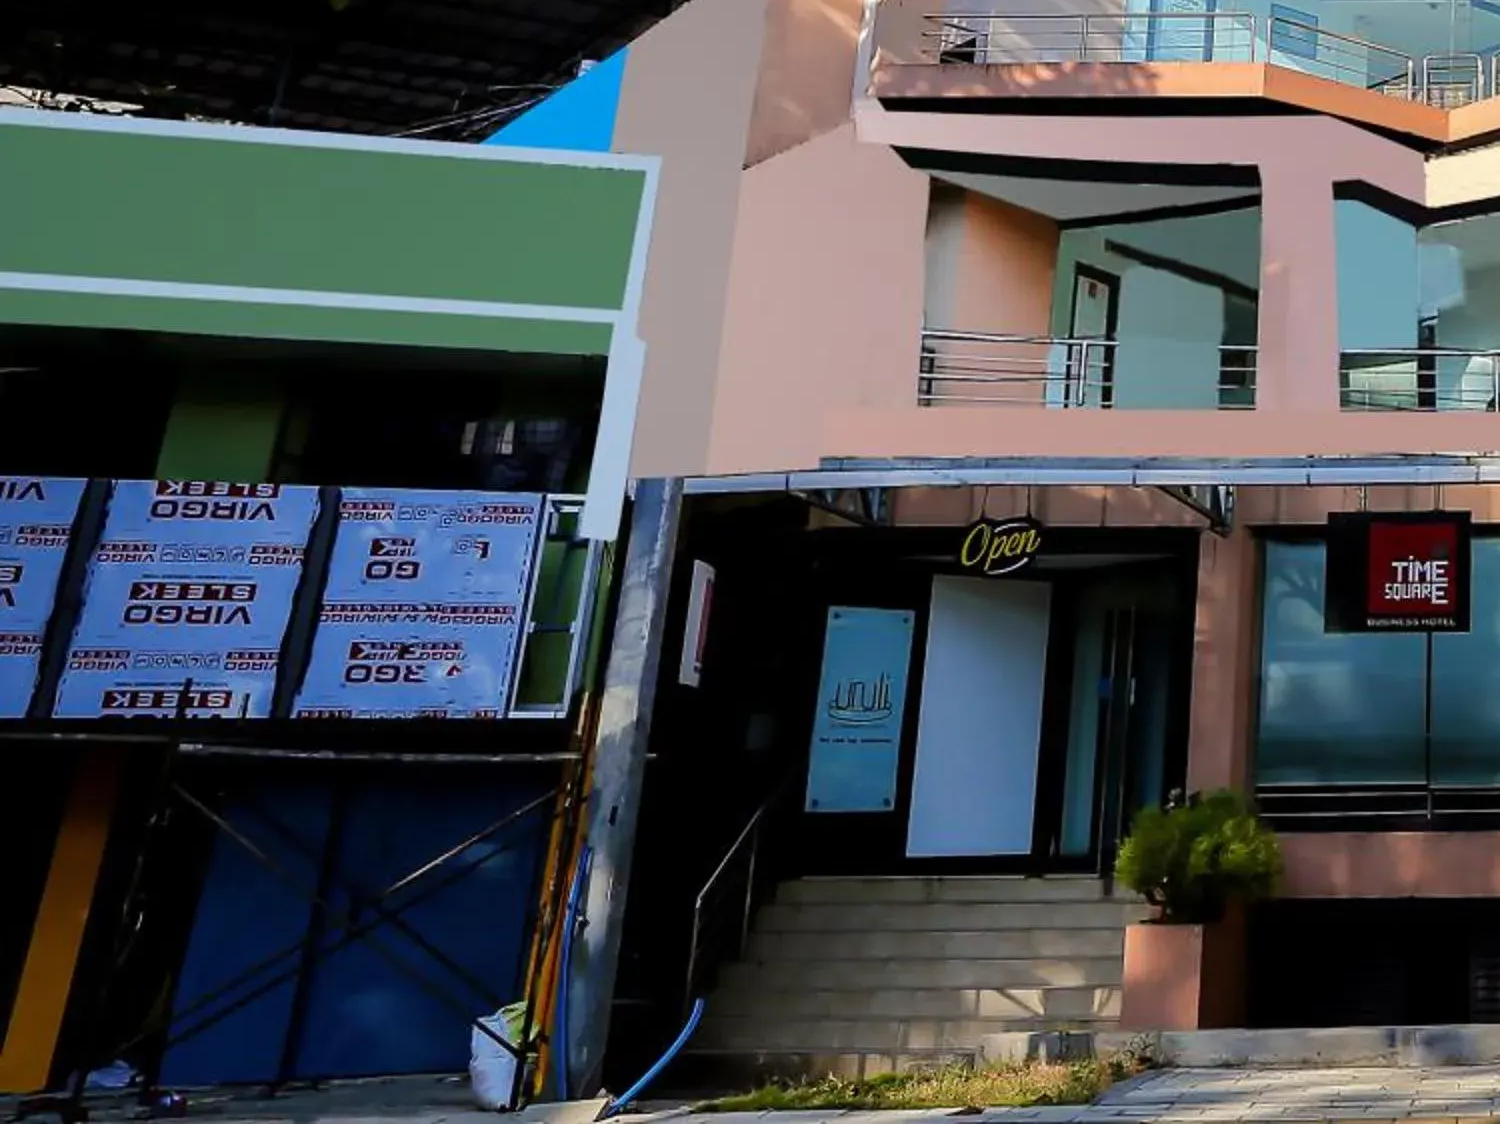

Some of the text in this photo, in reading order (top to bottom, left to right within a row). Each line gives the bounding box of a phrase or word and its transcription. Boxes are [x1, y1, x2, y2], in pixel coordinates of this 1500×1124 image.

[150, 500, 276, 521] VIRGO
[961, 523, 1041, 572] Open
[138, 583, 252, 600] SLEEK
[1384, 583, 1449, 605] SQUARE
[123, 604, 252, 625] VIRGO
[69, 660, 128, 671] VIRGO
[111, 692, 228, 709] SLEEK
